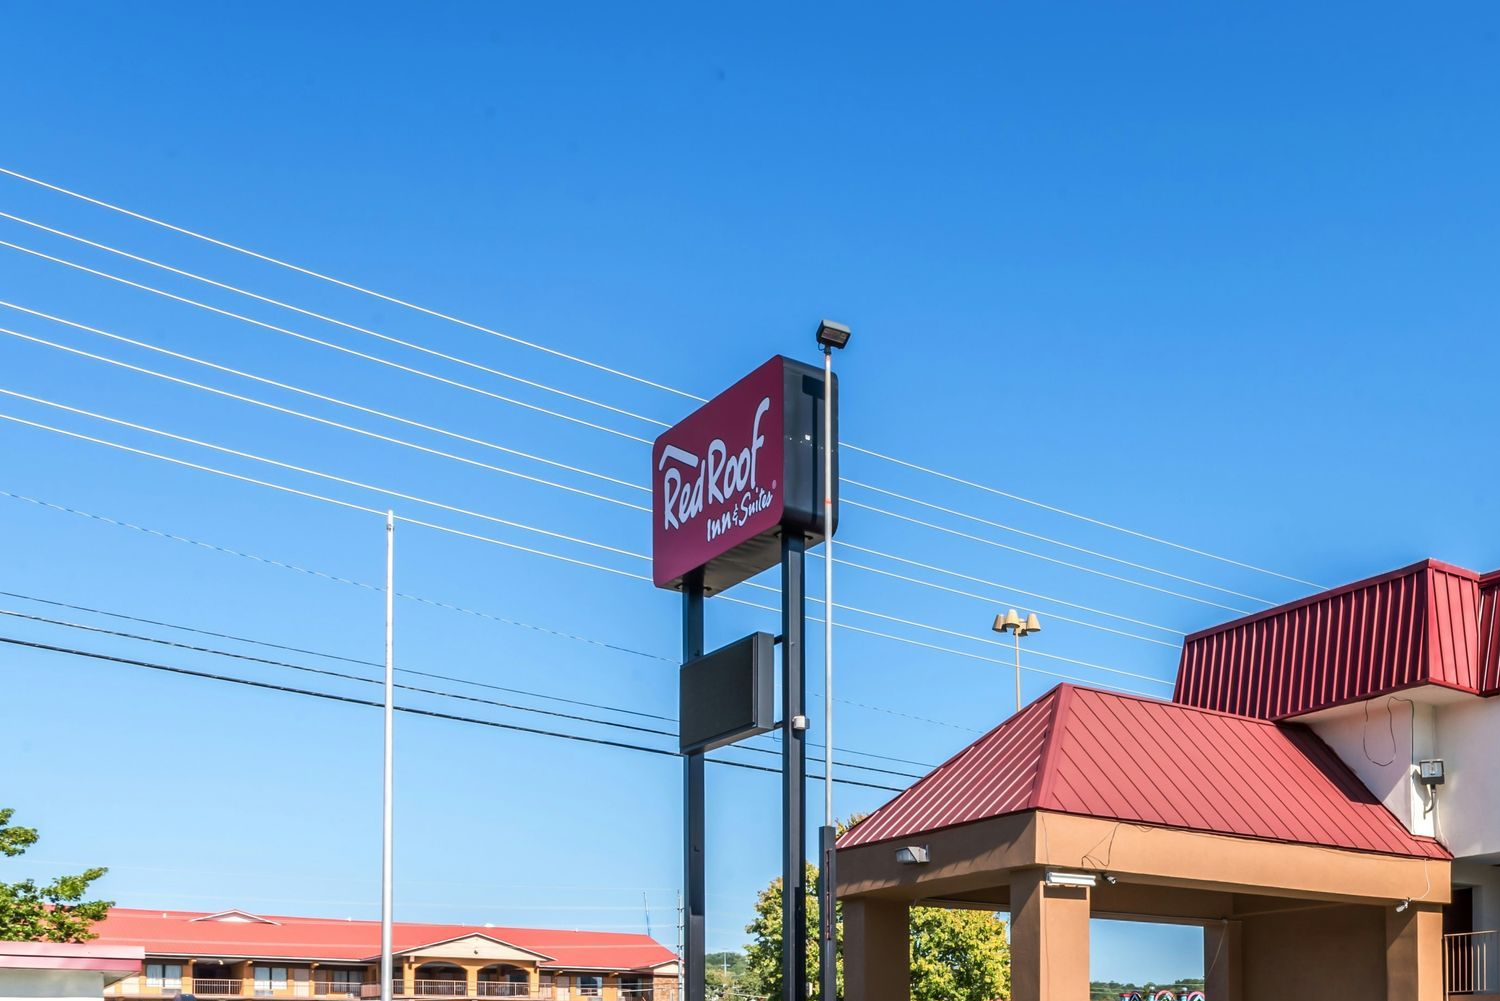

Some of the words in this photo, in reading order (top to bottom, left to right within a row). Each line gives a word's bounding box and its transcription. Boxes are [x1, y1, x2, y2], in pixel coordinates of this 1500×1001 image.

[664, 460, 706, 530] Red
[707, 397, 770, 505] Roof
[707, 514, 732, 542] Inn
[732, 507, 739, 526] &
[738, 488, 774, 528] Suites
